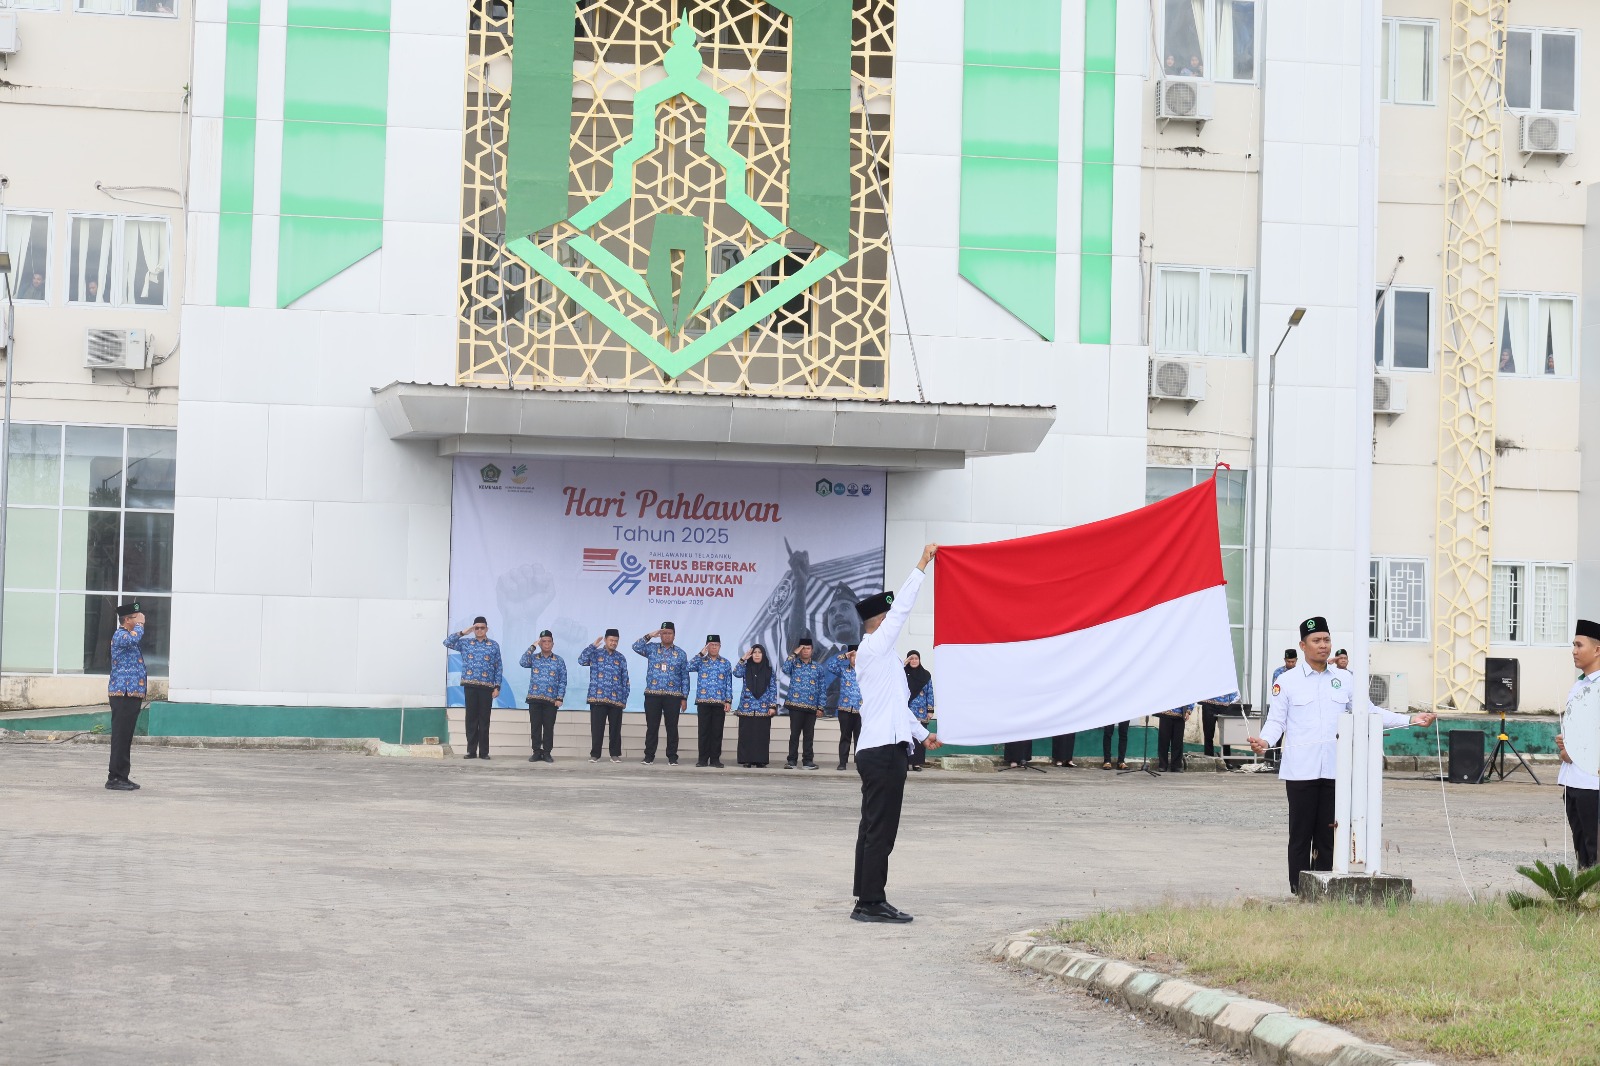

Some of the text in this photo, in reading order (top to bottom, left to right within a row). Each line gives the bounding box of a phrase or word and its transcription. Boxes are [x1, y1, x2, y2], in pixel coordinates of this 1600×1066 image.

[562, 486, 782, 523] Hari Pahlawan
[612, 525, 729, 544] Tahun 2025
[649, 551, 693, 559] PAHLAWANKU
[648, 559, 757, 573] TERUS BERGERAK
[648, 572, 743, 585] MELANJUTKAN
[648, 585, 734, 598] PERJUANGAN
